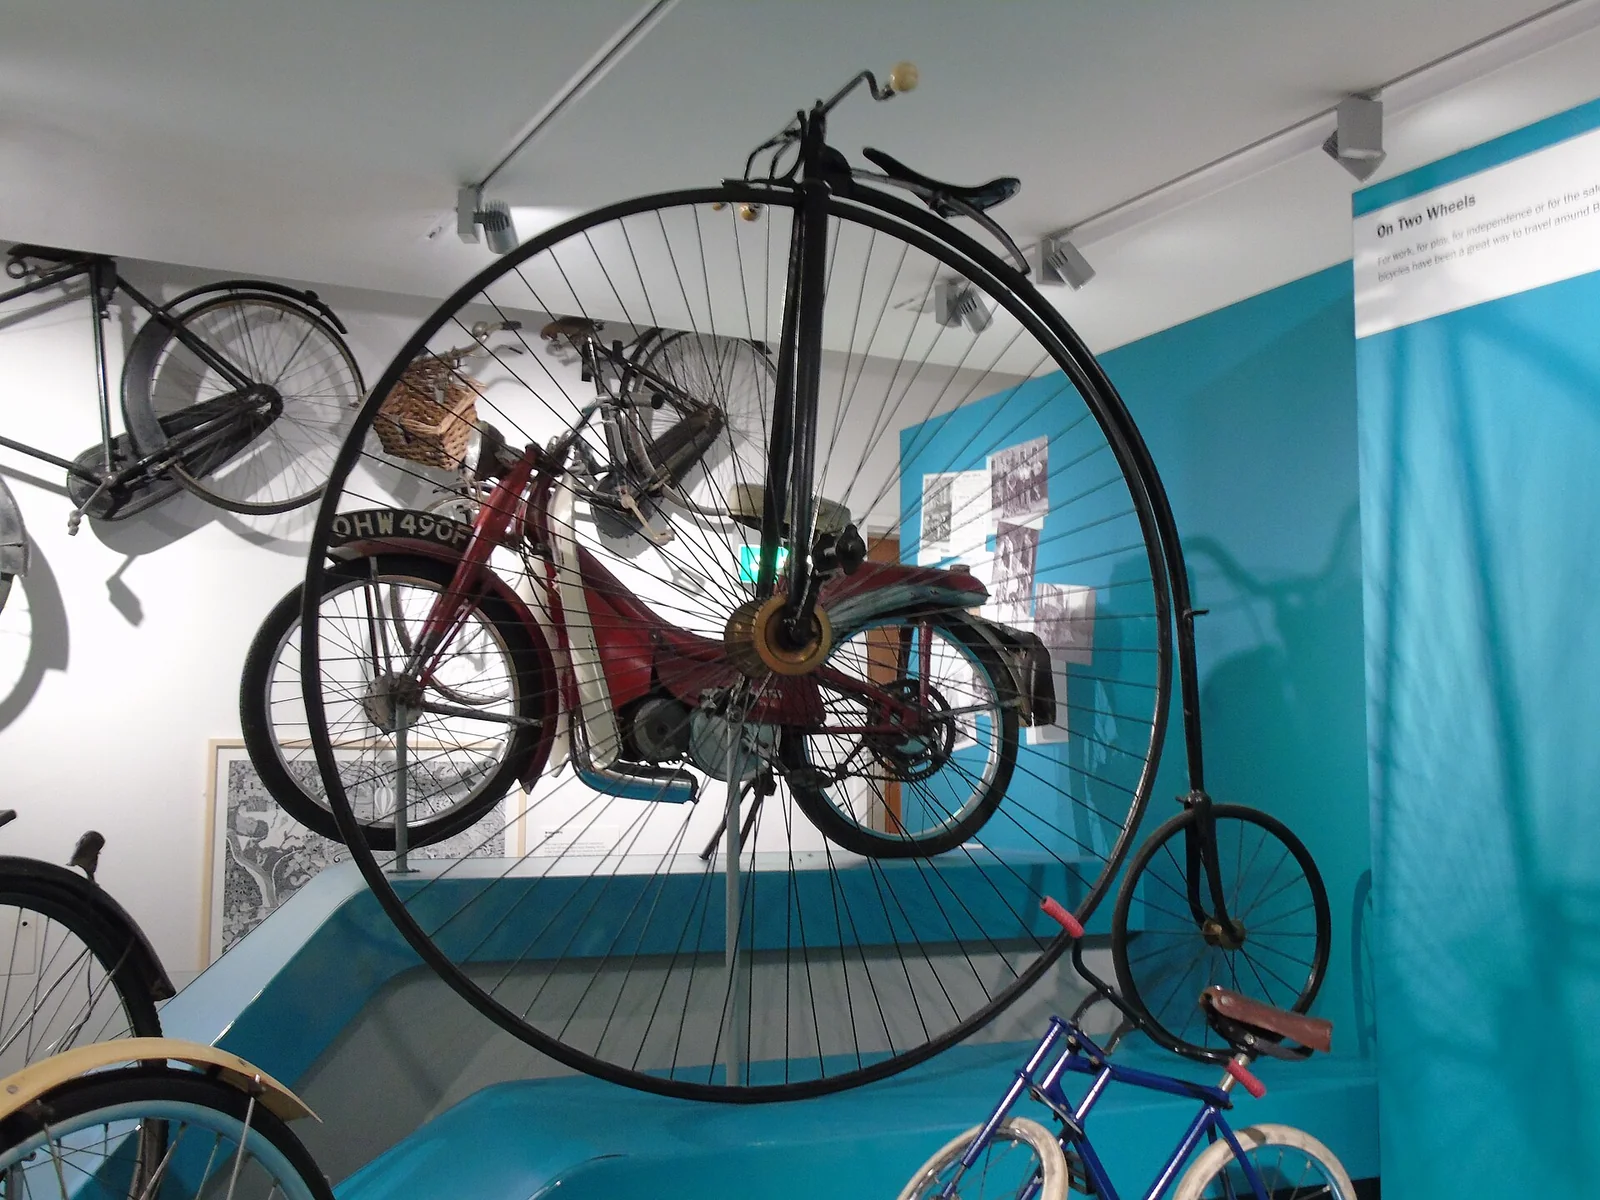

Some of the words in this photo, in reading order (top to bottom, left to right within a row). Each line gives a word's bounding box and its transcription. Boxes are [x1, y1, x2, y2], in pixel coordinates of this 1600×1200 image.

[1377, 222, 1394, 238] On
[1398, 214, 1422, 231] Two
[1426, 194, 1476, 220] Wheels
[1467, 205, 1532, 238] independence
[1534, 203, 1545, 214] or
[1547, 197, 1560, 210] for
[1563, 191, 1580, 204] the
[1377, 264, 1410, 283] bicycles
[1411, 257, 1433, 272] have
[1434, 249, 1457, 265] been
[1466, 238, 1490, 256] great
[1492, 232, 1511, 247] way
[1512, 227, 1522, 239] to
[1524, 216, 1552, 235] travel
[1554, 205, 1590, 227] around
[332, 512, 394, 538] OHW
[400, 513, 474, 544] 490F
